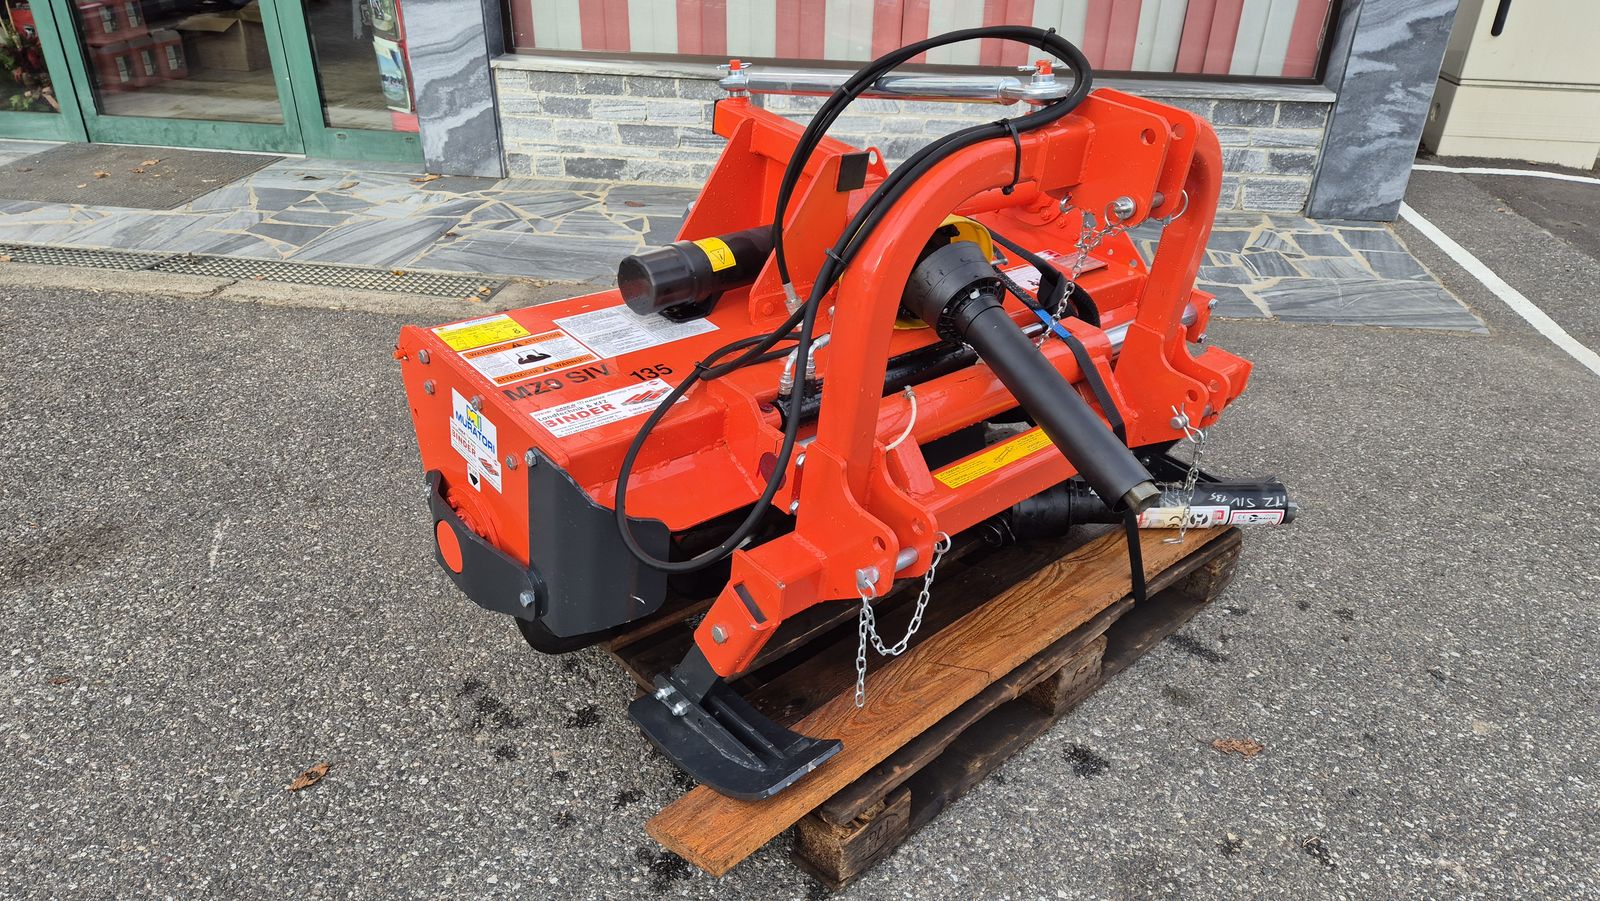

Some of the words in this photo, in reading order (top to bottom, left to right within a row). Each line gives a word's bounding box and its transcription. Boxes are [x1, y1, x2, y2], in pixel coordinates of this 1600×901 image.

[468, 345, 507, 357] WARNING
[524, 331, 562, 344] ATTENTION
[565, 363, 610, 383] SIV
[630, 363, 673, 381] 135
[543, 403, 617, 427] BINDER
[451, 429, 477, 457] BINDER
[455, 410, 496, 454] MURATORI
